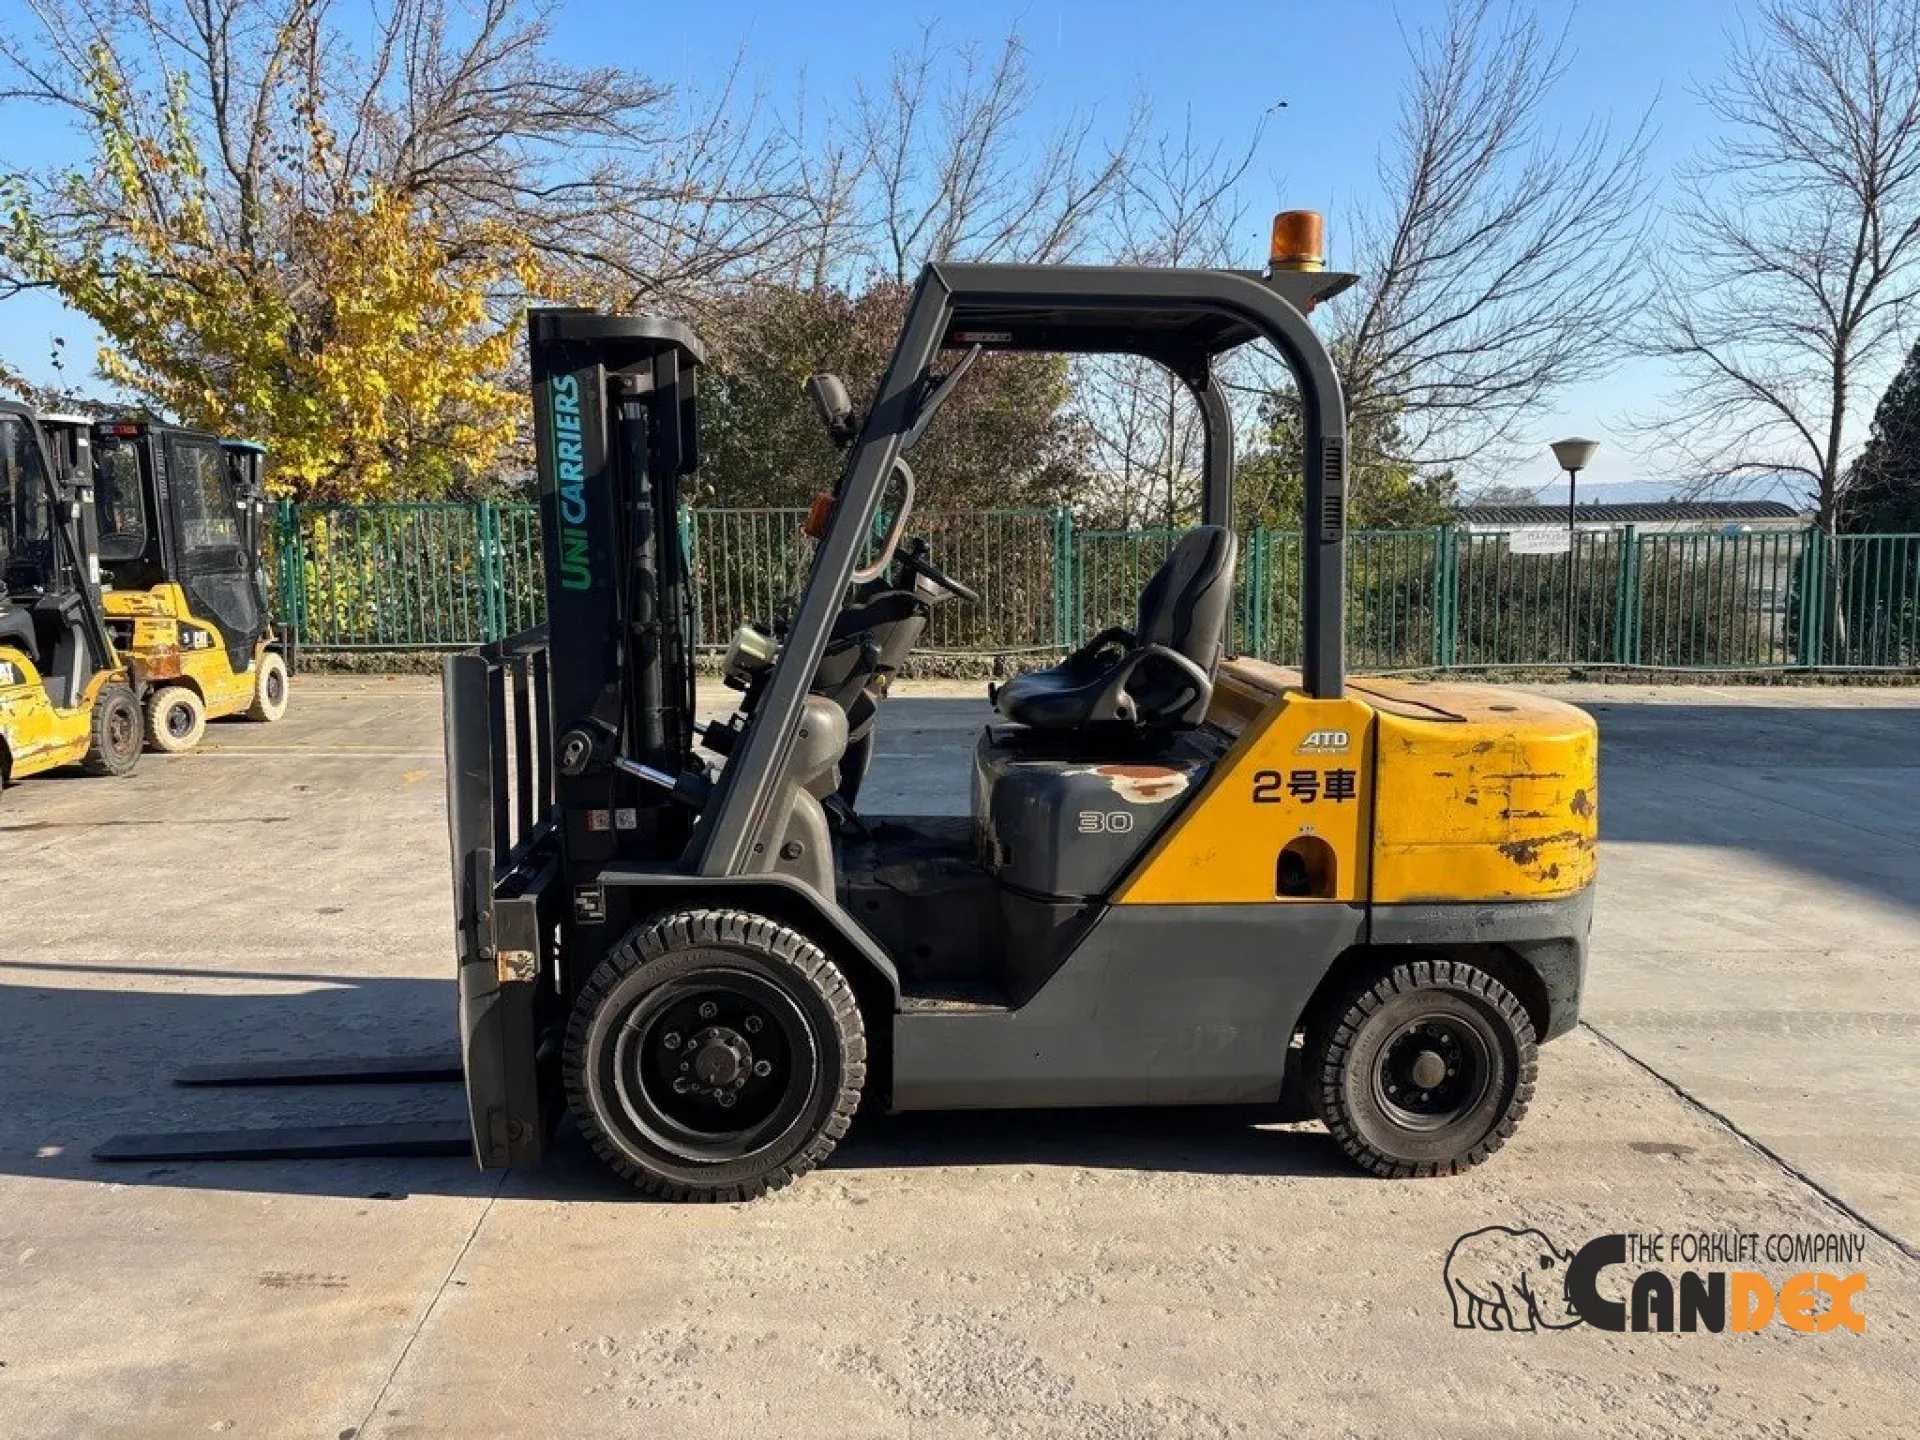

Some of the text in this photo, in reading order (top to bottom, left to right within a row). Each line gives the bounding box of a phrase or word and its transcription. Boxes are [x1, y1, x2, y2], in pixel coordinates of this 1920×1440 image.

[552, 374, 592, 591] UNICARRIERS
[1301, 731, 1349, 746] ATD
[1252, 768, 1357, 804] 2号車
[1078, 811, 1133, 833] 30
